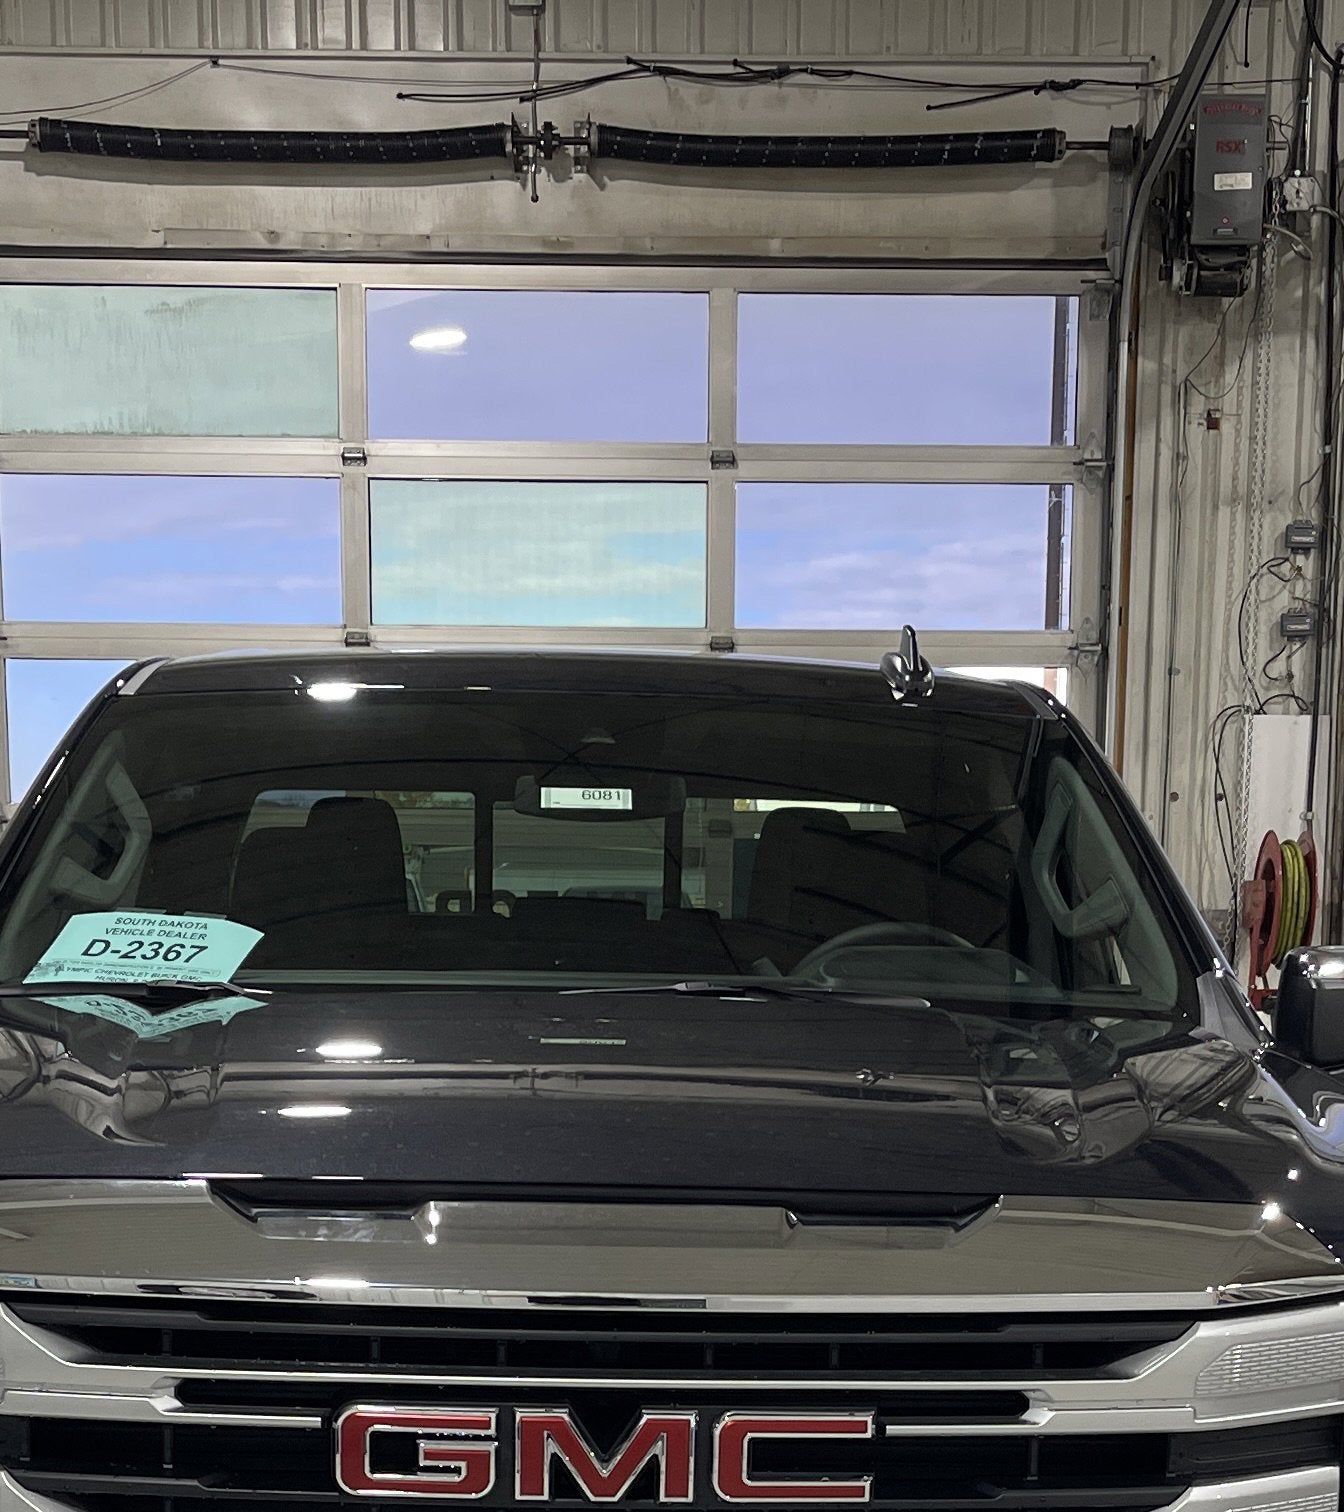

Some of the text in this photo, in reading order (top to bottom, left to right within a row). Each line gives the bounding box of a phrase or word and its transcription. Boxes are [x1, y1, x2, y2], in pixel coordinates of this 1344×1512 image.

[581, 789, 621, 801] 6081
[114, 917, 208, 930] SOUTH DAKOTA
[105, 927, 207, 941] VEHICLE DEALER
[80, 938, 209, 964] D-2367
[334, 1404, 874, 1502] GMC
